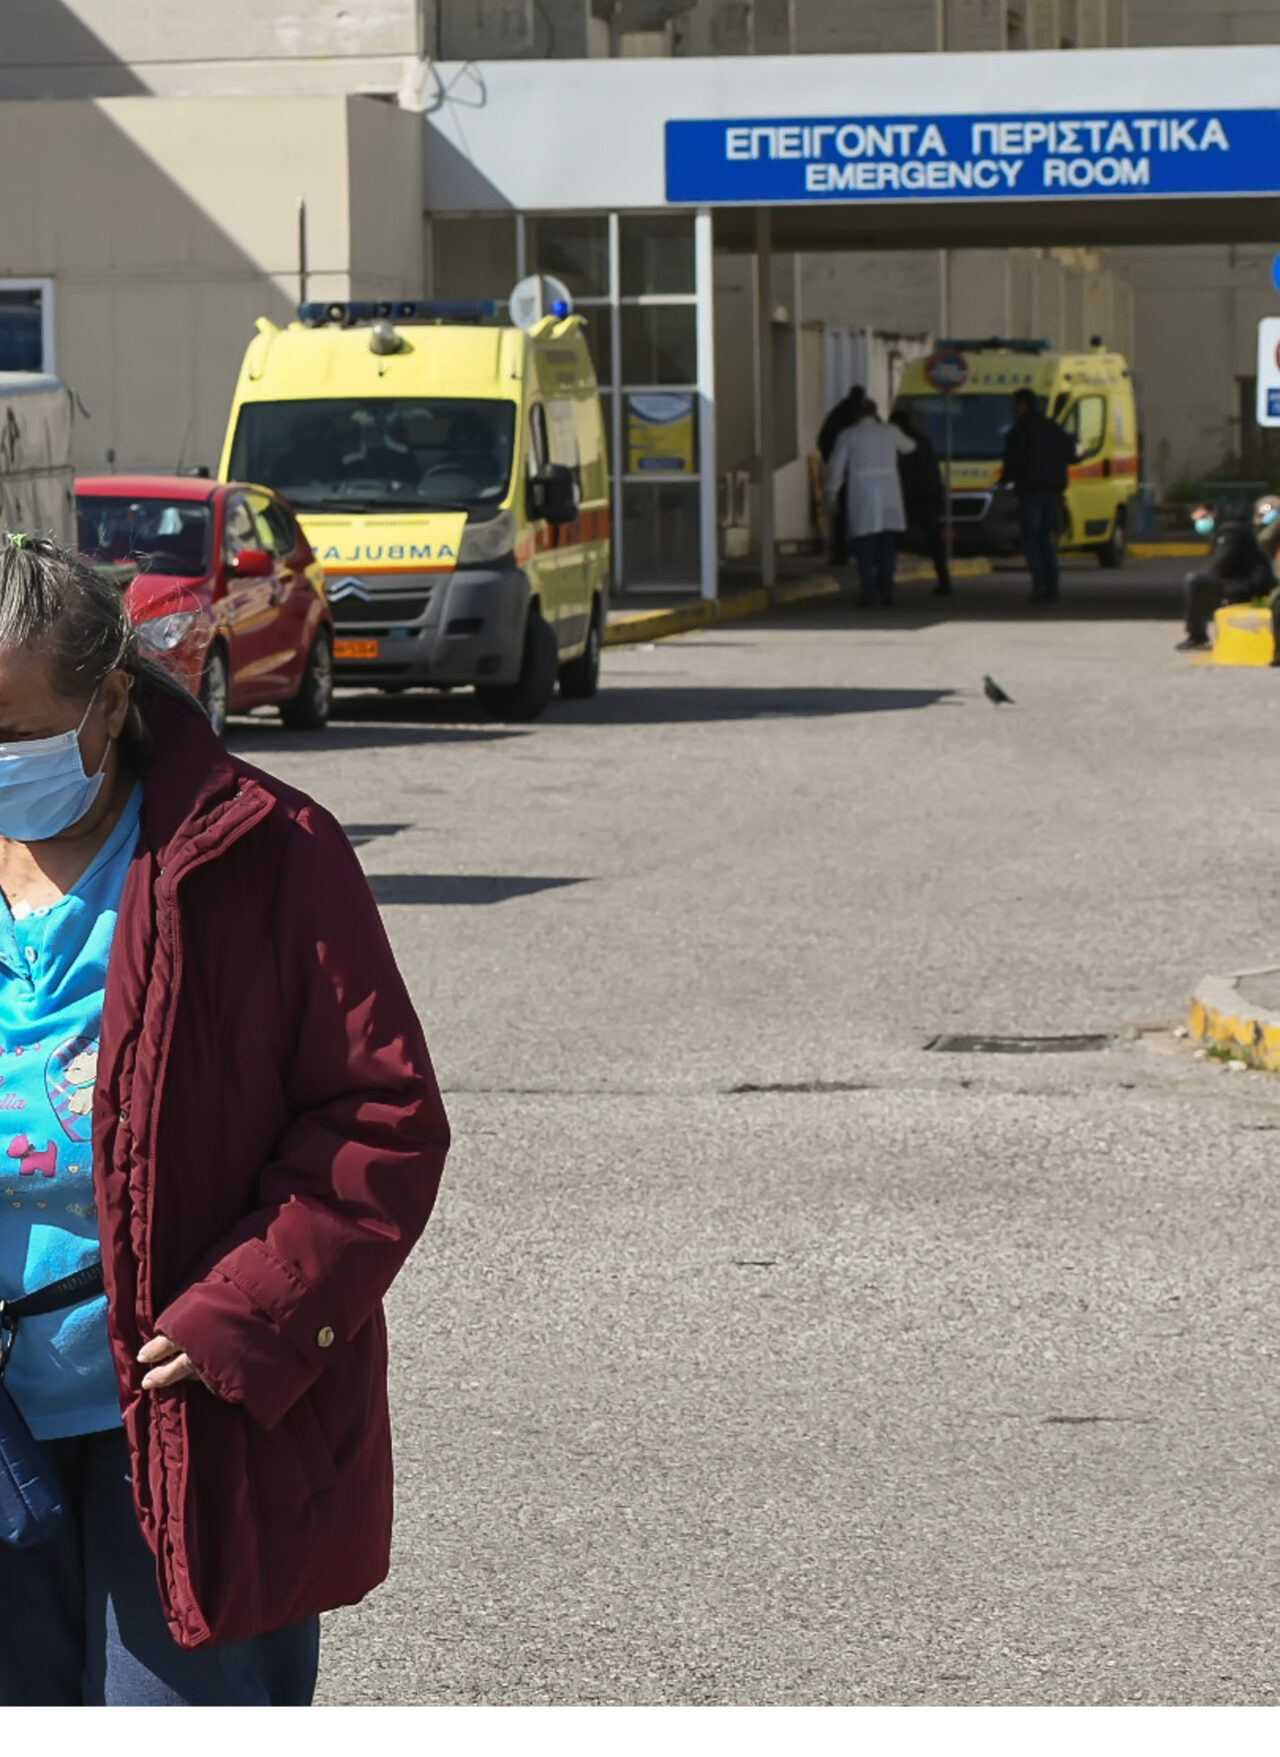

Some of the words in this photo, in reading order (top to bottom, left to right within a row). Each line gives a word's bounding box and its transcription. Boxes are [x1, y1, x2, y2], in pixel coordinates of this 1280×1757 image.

[725, 124, 948, 160] ΕΠΕΙΓΟΝΤΑ
[972, 118, 1230, 154] ΠΕΡΙΣΤΑΤΙΚΑ
[805, 160, 1023, 191] EMERGENCY
[1044, 158, 1151, 186] ROOM
